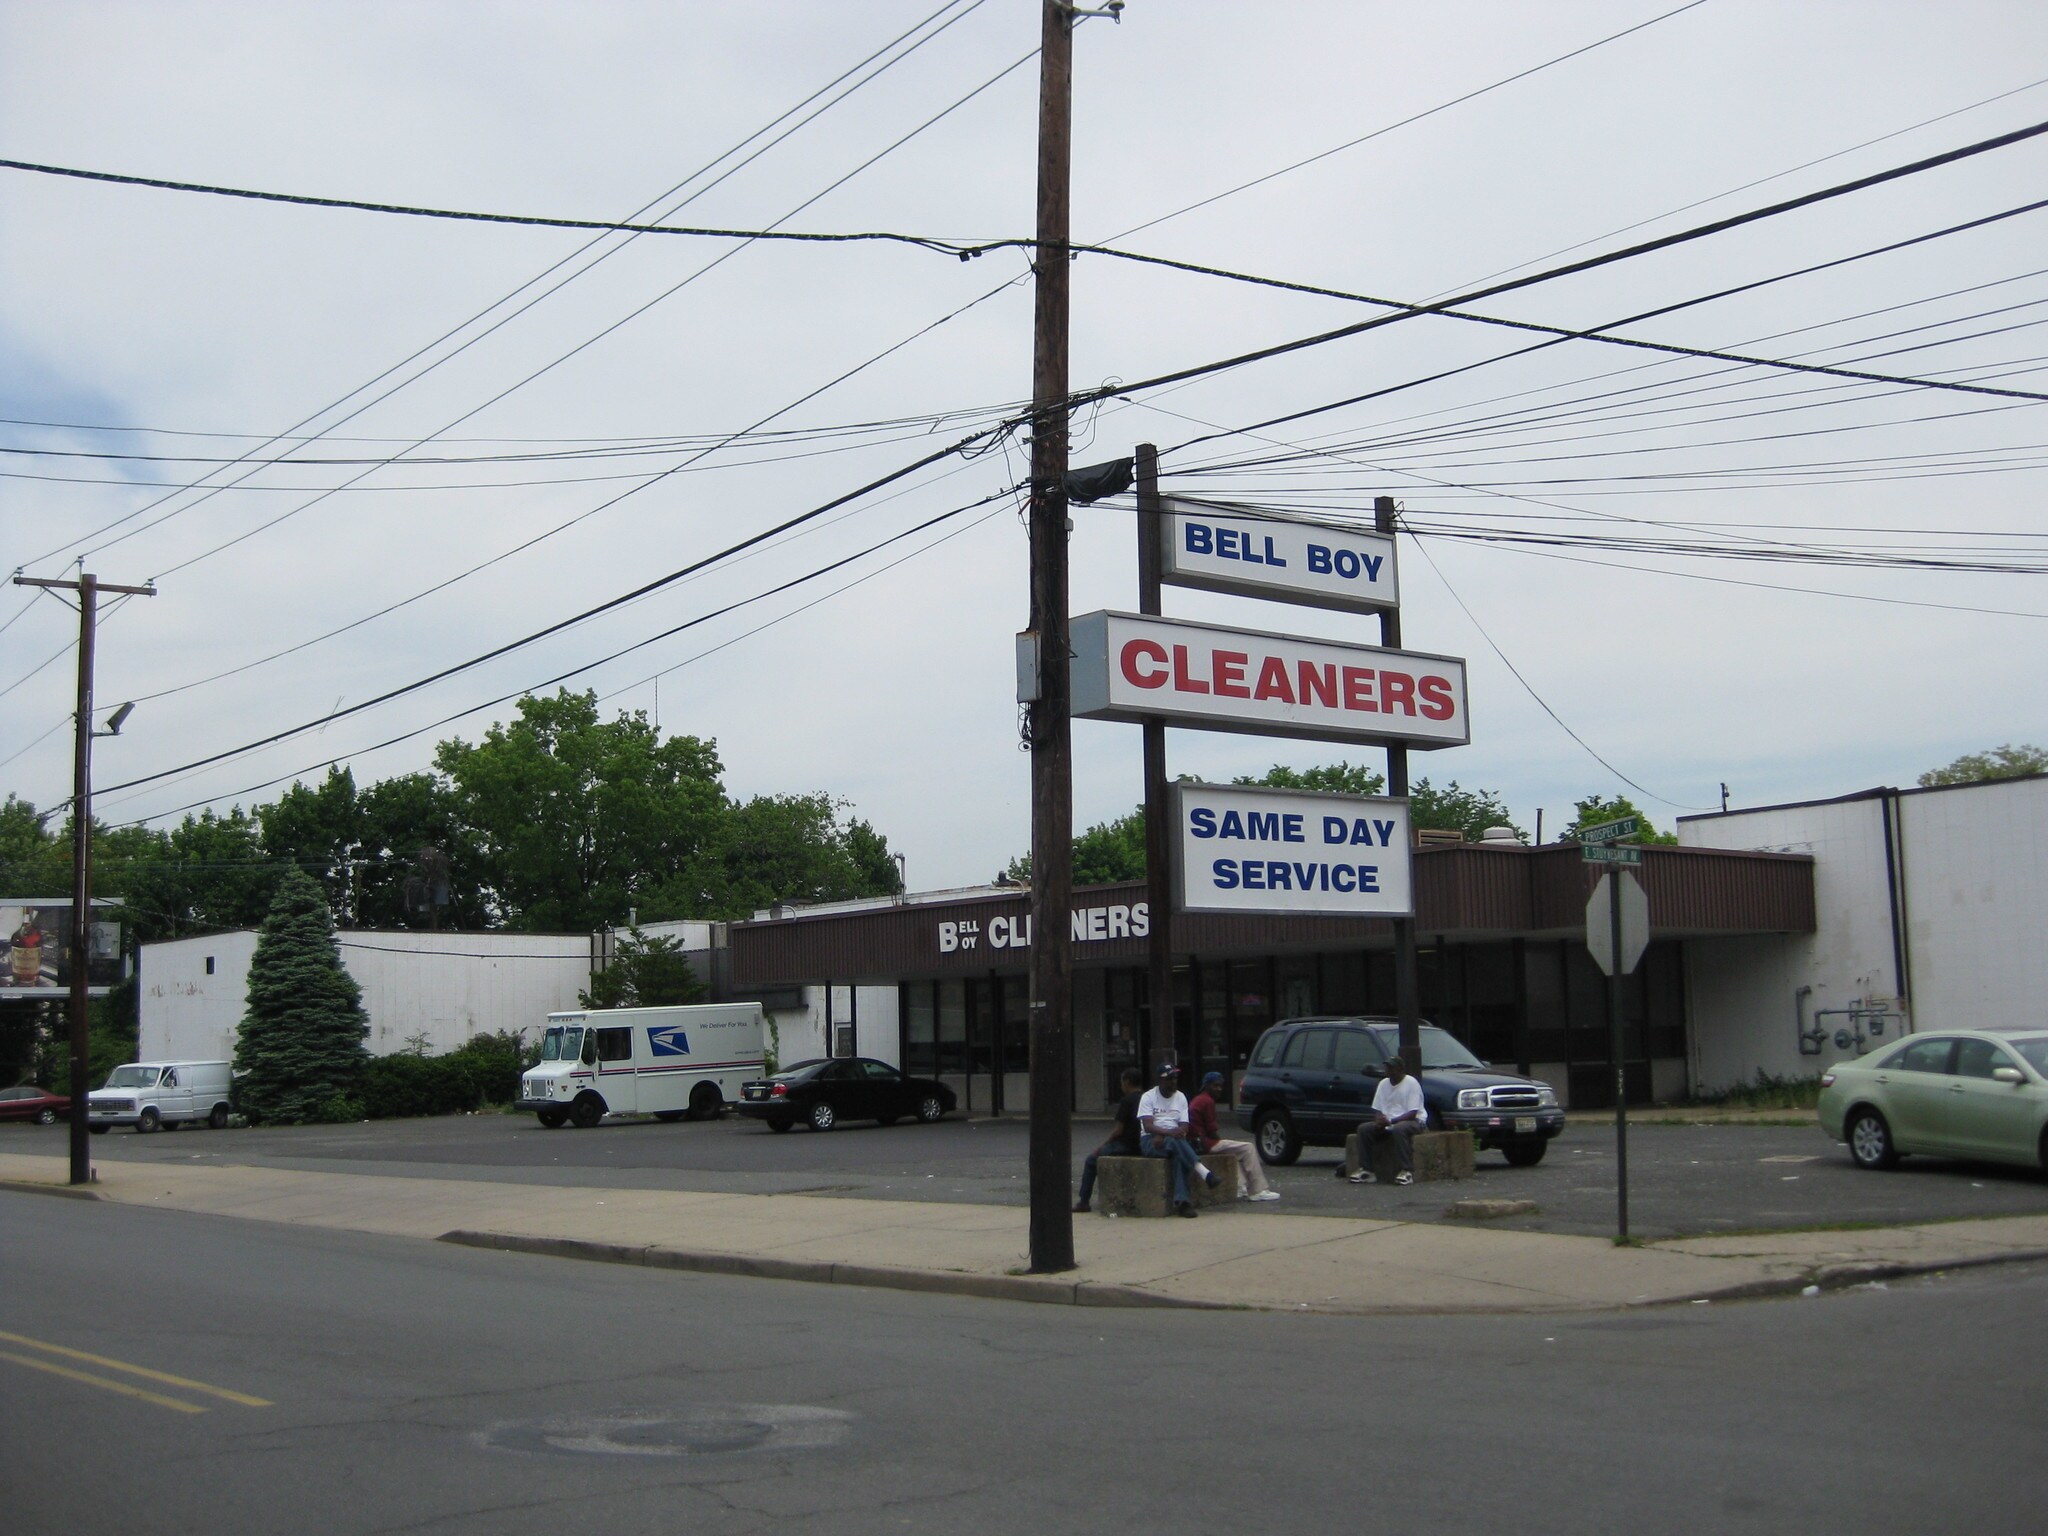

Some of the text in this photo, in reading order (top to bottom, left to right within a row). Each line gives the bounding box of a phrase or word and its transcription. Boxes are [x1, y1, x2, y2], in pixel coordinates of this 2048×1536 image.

[1185, 522, 1383, 583] BELL BOY
[1120, 639, 1455, 721] CLEANERS
[1190, 807, 1396, 848] SAME DAY
[1585, 821, 1633, 842] PROSPECT ST
[1592, 847, 1628, 861] STUYVESANT
[1212, 859, 1380, 893] SERVICE
[988, 902, 1150, 949] CLNERS
